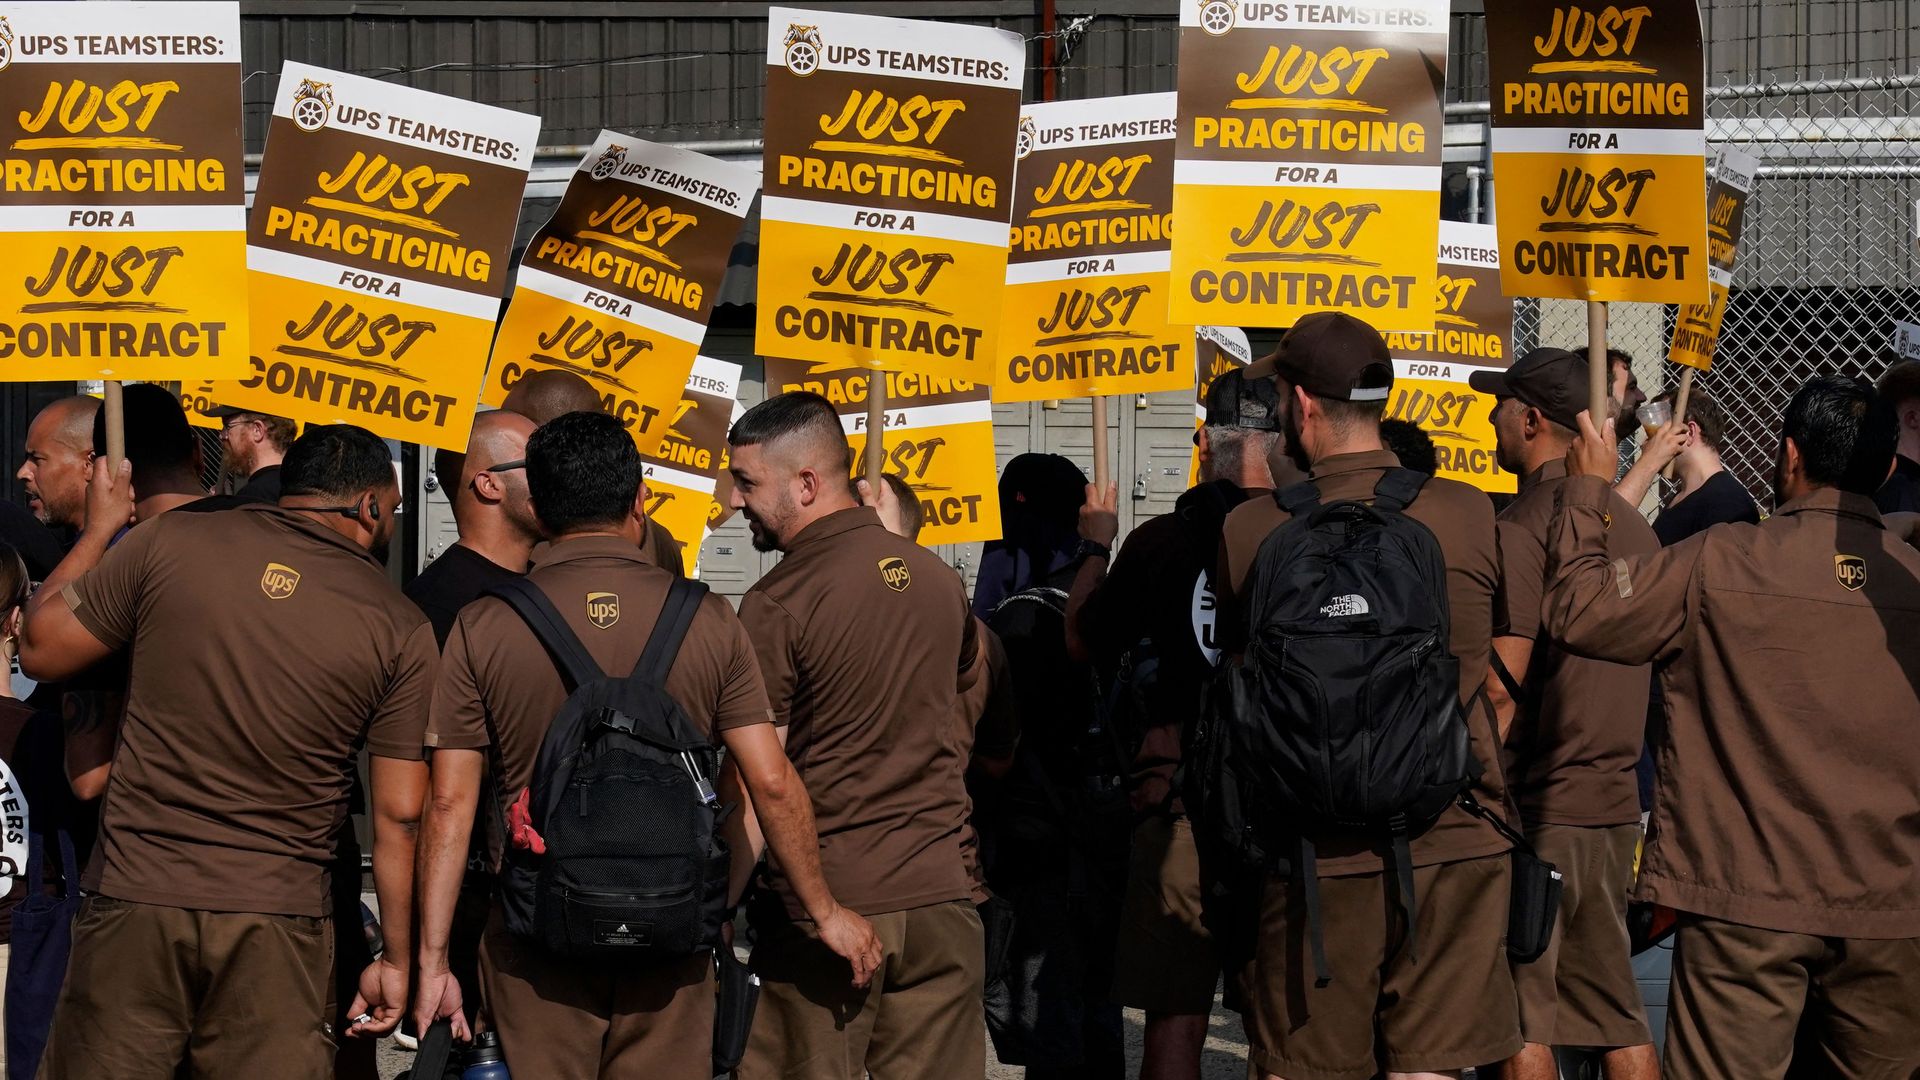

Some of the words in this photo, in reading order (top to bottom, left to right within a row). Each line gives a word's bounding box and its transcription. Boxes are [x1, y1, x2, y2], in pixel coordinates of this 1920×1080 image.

[1243, 3, 1288, 22] UPS
[1534, 5, 1652, 57] JUST
[20, 35, 67, 56] UPS
[74, 35, 224, 56] TEAMSTERS:
[827, 45, 871, 66] UPS
[876, 49, 1010, 81] TEAMSTERS:
[1236, 44, 1389, 95] JUST
[18, 79, 180, 134] JUST
[819, 89, 966, 144] JUST
[1504, 82, 1689, 116] PRACTICING
[336, 105, 381, 130] UPS
[387, 115, 520, 162] TEAMSTERS:
[1040, 128, 1074, 144] UPS
[1194, 117, 1425, 153] PRACTICING
[1569, 133, 1601, 149] FOR
[1605, 133, 1619, 149] A
[0, 159, 225, 192] RACTICING
[317, 151, 470, 214] JUST
[620, 162, 650, 179] UPS
[650, 168, 741, 209] TEAMSTERS:
[778, 155, 997, 208] PRACTICING
[1034, 154, 1153, 204] JUST
[1275, 167, 1320, 183] FOR
[1323, 168, 1338, 183] A
[1541, 166, 1656, 218] JUST
[68, 210, 114, 227] FOR
[118, 210, 135, 227] A
[588, 194, 698, 248] JUST
[854, 211, 896, 230] FOR
[899, 216, 916, 231] A
[1230, 199, 1381, 249] JUST
[1710, 192, 1737, 227] JUST
[265, 205, 491, 282] PRACTICING
[1514, 240, 1689, 281] CONTRACT
[25, 244, 184, 298] JUST
[338, 270, 384, 293] FOR
[386, 282, 402, 297] A
[536, 236, 703, 311] PRACTICING
[811, 243, 955, 296] JUST
[1067, 260, 1098, 275] FOR
[1102, 258, 1115, 272] A
[583, 290, 619, 314] FOR
[619, 304, 633, 318] A
[1190, 269, 1416, 309] CONTRACT
[1037, 284, 1150, 333] JUST
[285, 299, 437, 361] JUST
[538, 315, 653, 373] JUST
[775, 305, 983, 361] CONTRACT
[1008, 343, 1180, 384] CONTRACT
[1408, 364, 1437, 377] FOR
[1441, 366, 1451, 378] A
[238, 355, 457, 428] CONTRACT
[894, 413, 907, 426] A
[265, 571, 294, 592] ups
[884, 566, 908, 586] ups
[1838, 564, 1864, 585] ups
[590, 603, 617, 623] ups
[1320, 603, 1352, 613] NORTH
[1328, 609, 1352, 618] FACE
[1331, 595, 1351, 604] THE
